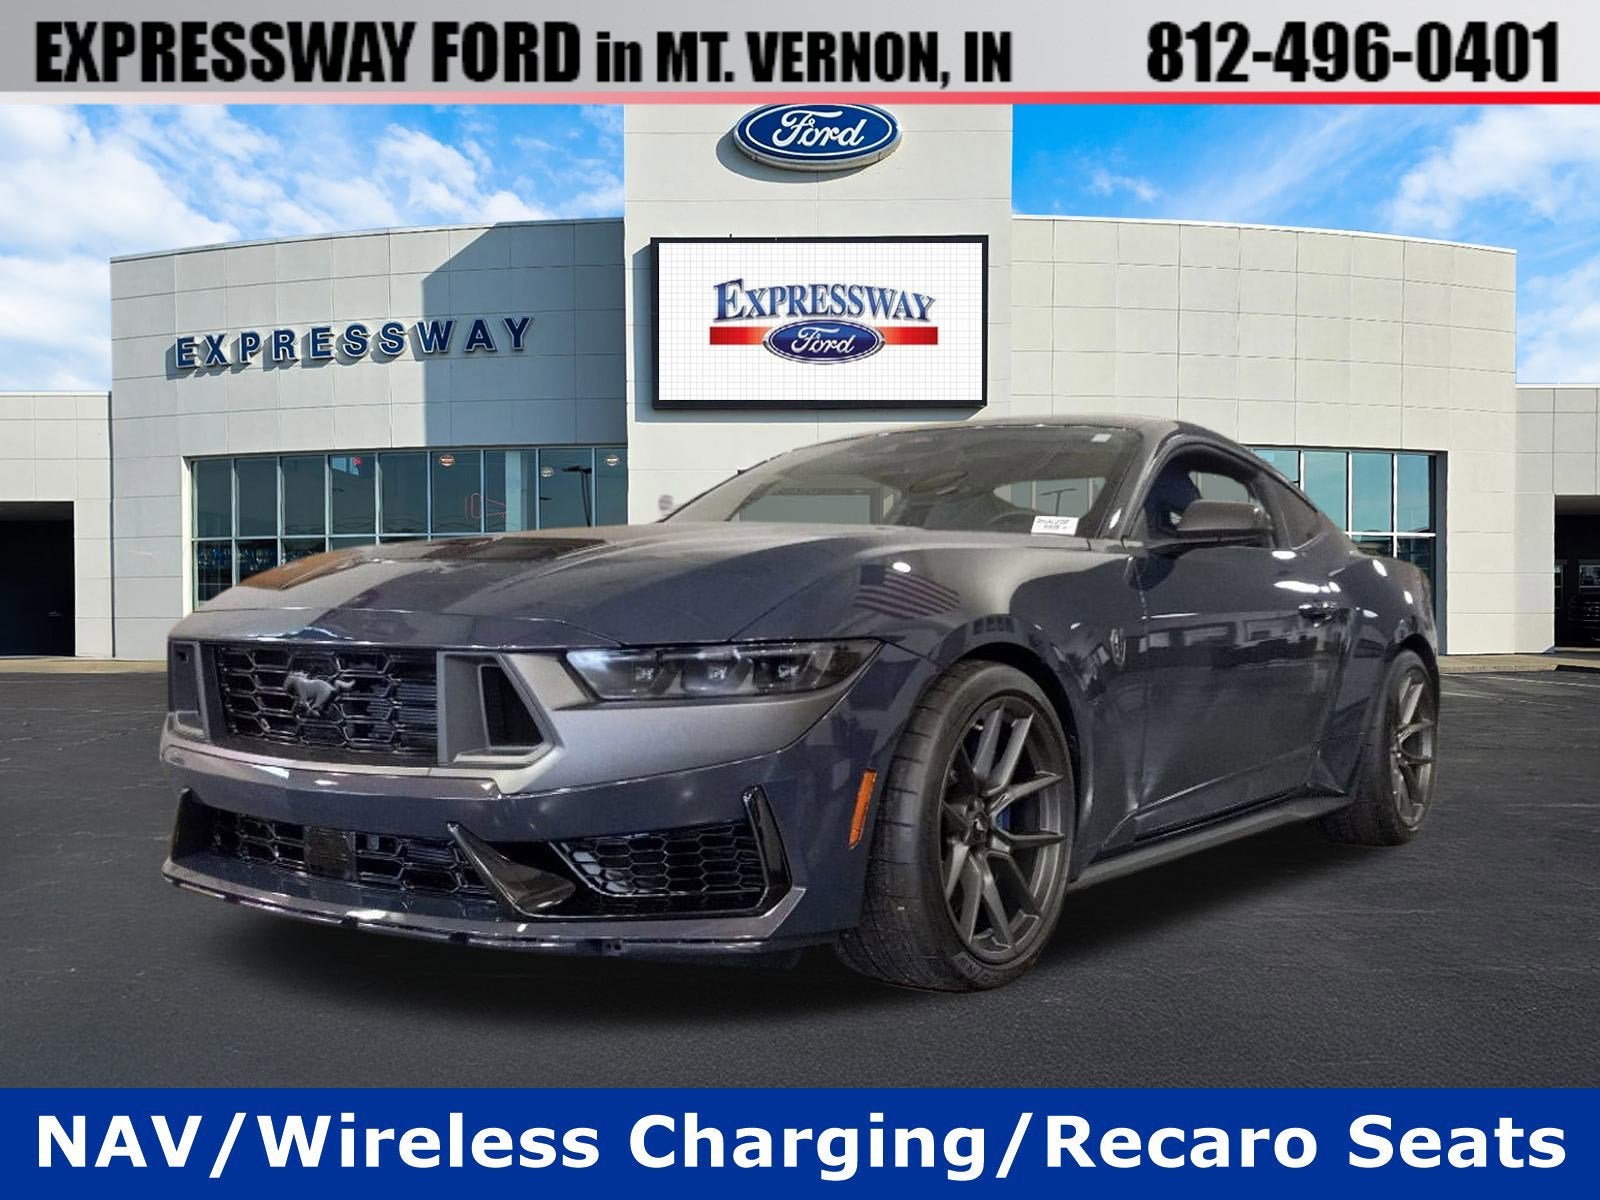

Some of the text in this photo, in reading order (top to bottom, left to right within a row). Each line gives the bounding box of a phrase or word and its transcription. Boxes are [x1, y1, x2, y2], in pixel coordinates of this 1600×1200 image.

[771, 109, 865, 148] Ford
[175, 316, 533, 369] EXPRESSWAY
[790, 326, 857, 354] Ford
